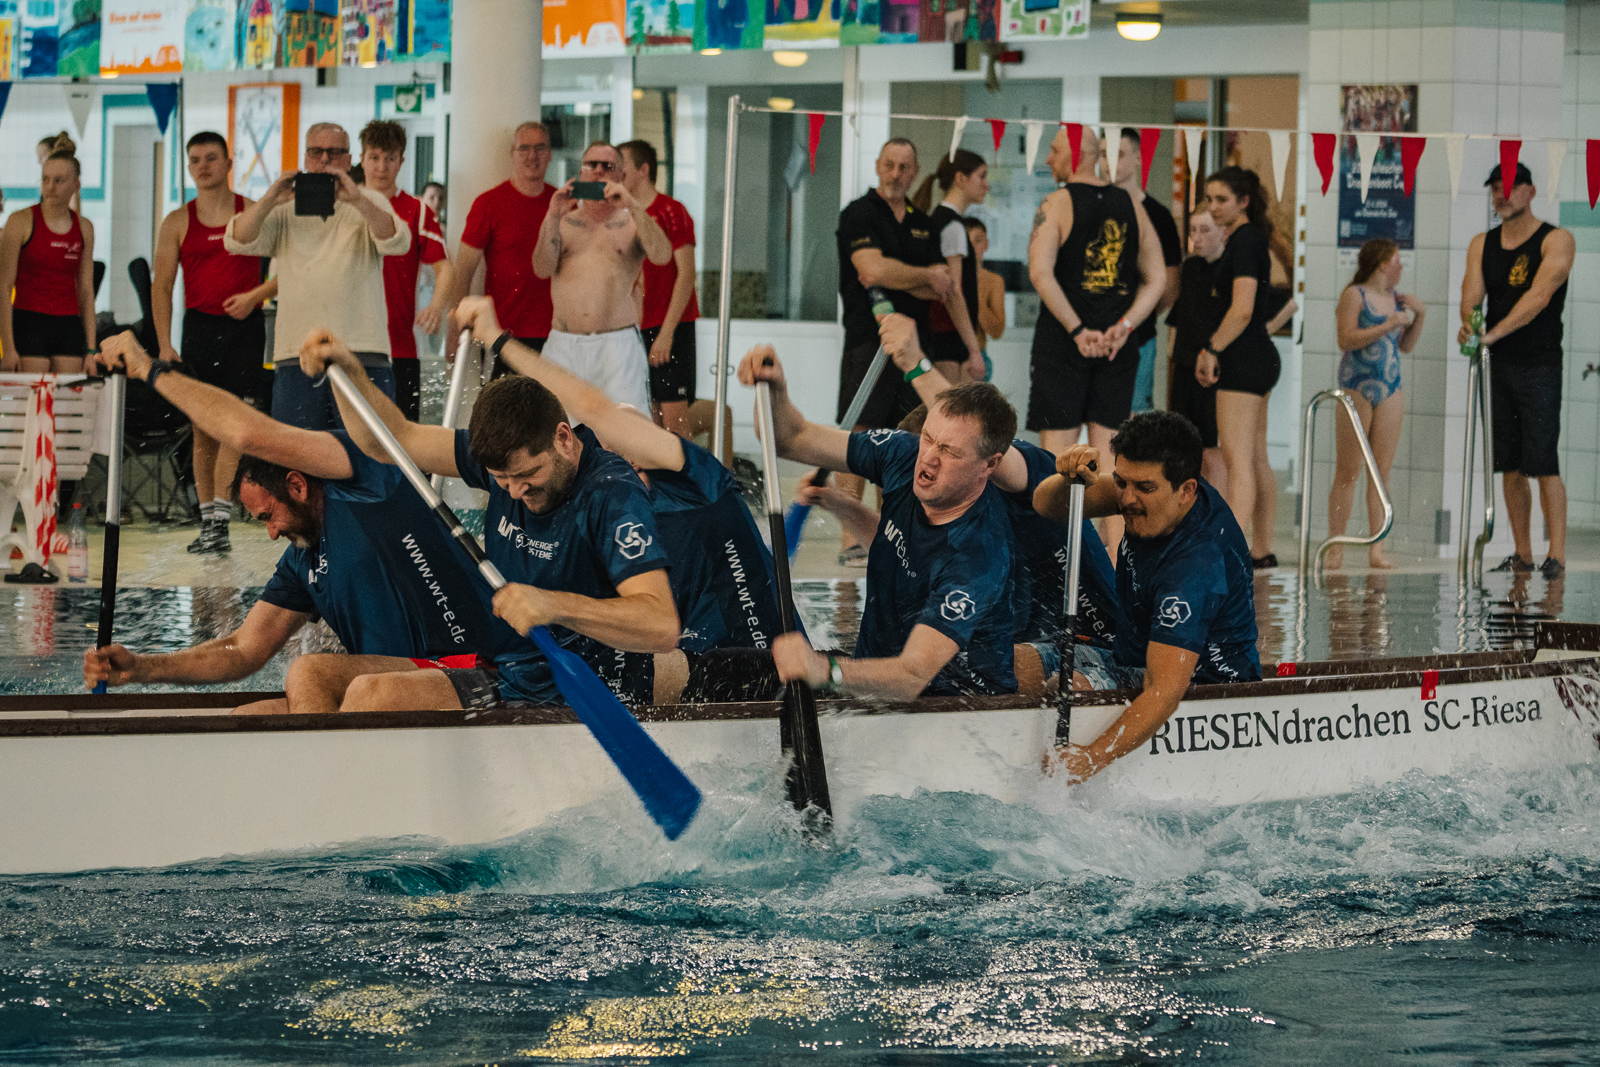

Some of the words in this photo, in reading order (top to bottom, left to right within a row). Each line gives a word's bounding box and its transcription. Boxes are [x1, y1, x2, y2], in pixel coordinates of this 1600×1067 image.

[724, 539, 768, 650] www.wt-e.de
[1149, 703, 1412, 755] RIESENdrachen
[1424, 695, 1542, 732] SC-Riesa
